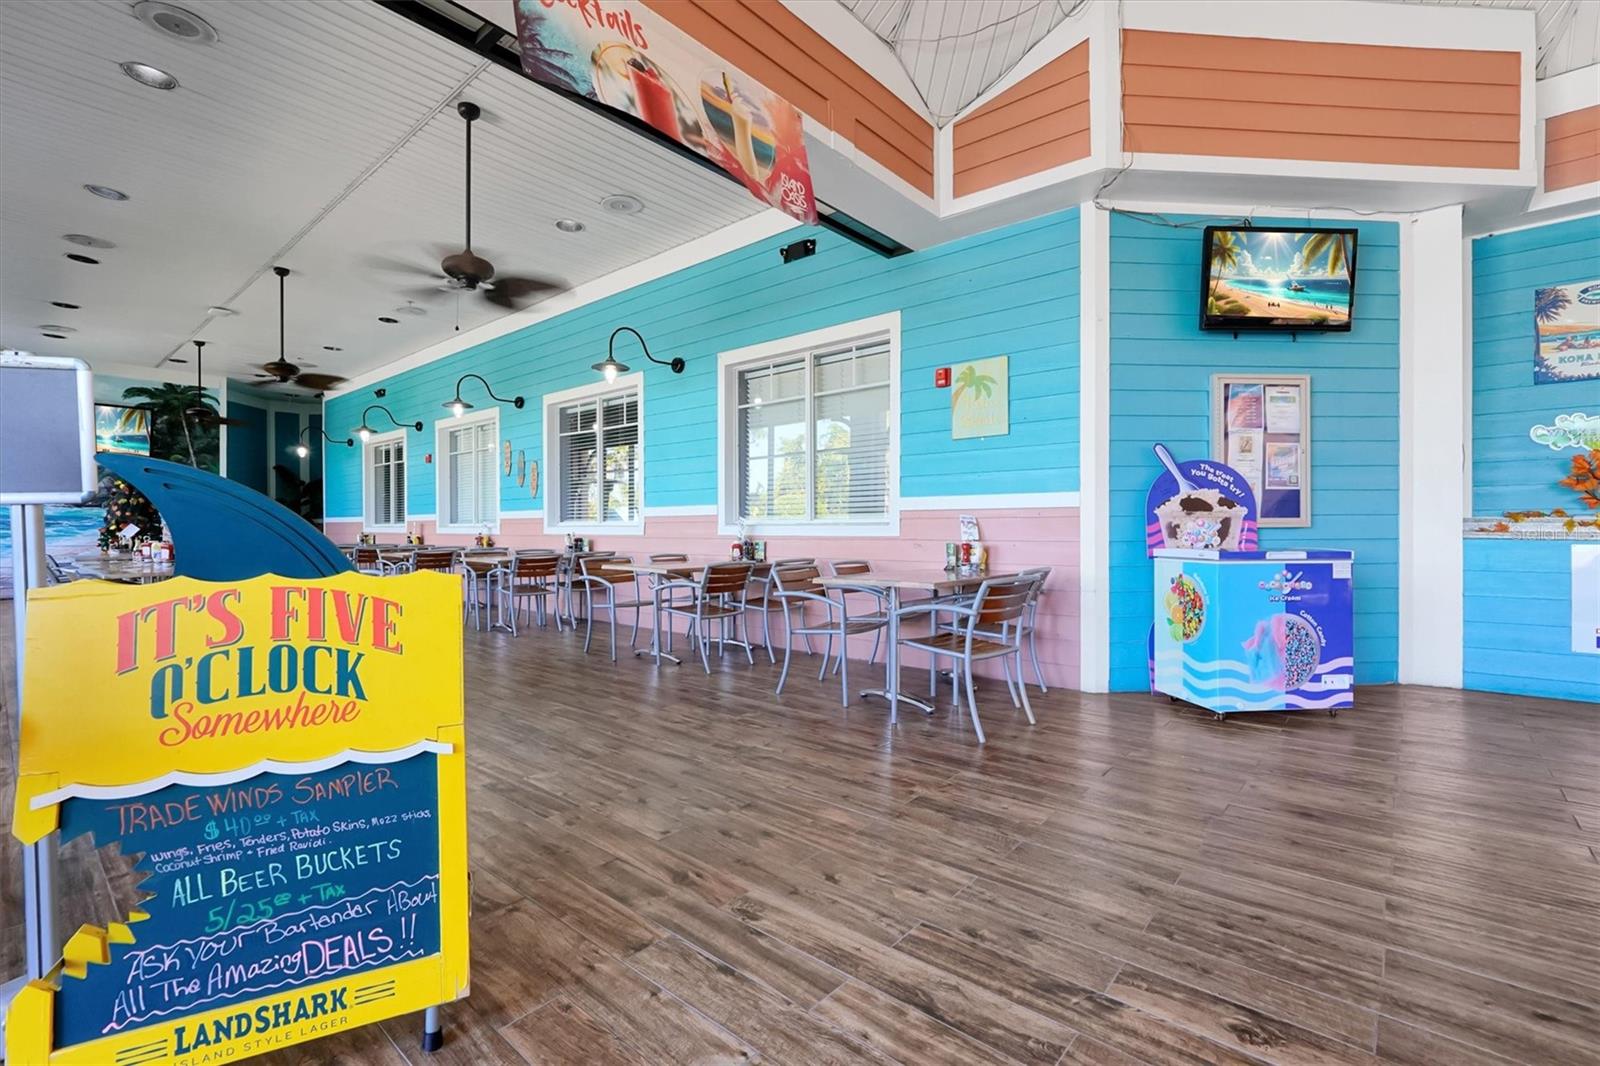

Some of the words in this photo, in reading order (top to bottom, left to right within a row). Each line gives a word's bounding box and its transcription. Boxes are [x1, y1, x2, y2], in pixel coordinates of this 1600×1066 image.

[1190, 469, 1206, 477] You
[1200, 463, 1214, 473] The
[115, 588, 244, 676] IT'S
[270, 586, 403, 655] FIVE
[150, 644, 368, 720] O'CLOCK
[159, 691, 360, 747] Somewhere
[104, 794, 202, 836] TRADE
[206, 783, 284, 816] WINDS
[172, 873, 213, 908] ALL
[220, 863, 288, 897] BEER
[295, 839, 402, 879] BUCKETS
[256, 844, 285, 857] Fried
[150, 977, 201, 1001] The
[174, 986, 348, 1056] LANDSHARK
[243, 1030, 293, 1050] STYLE
[300, 1016, 348, 1036] LAGER
